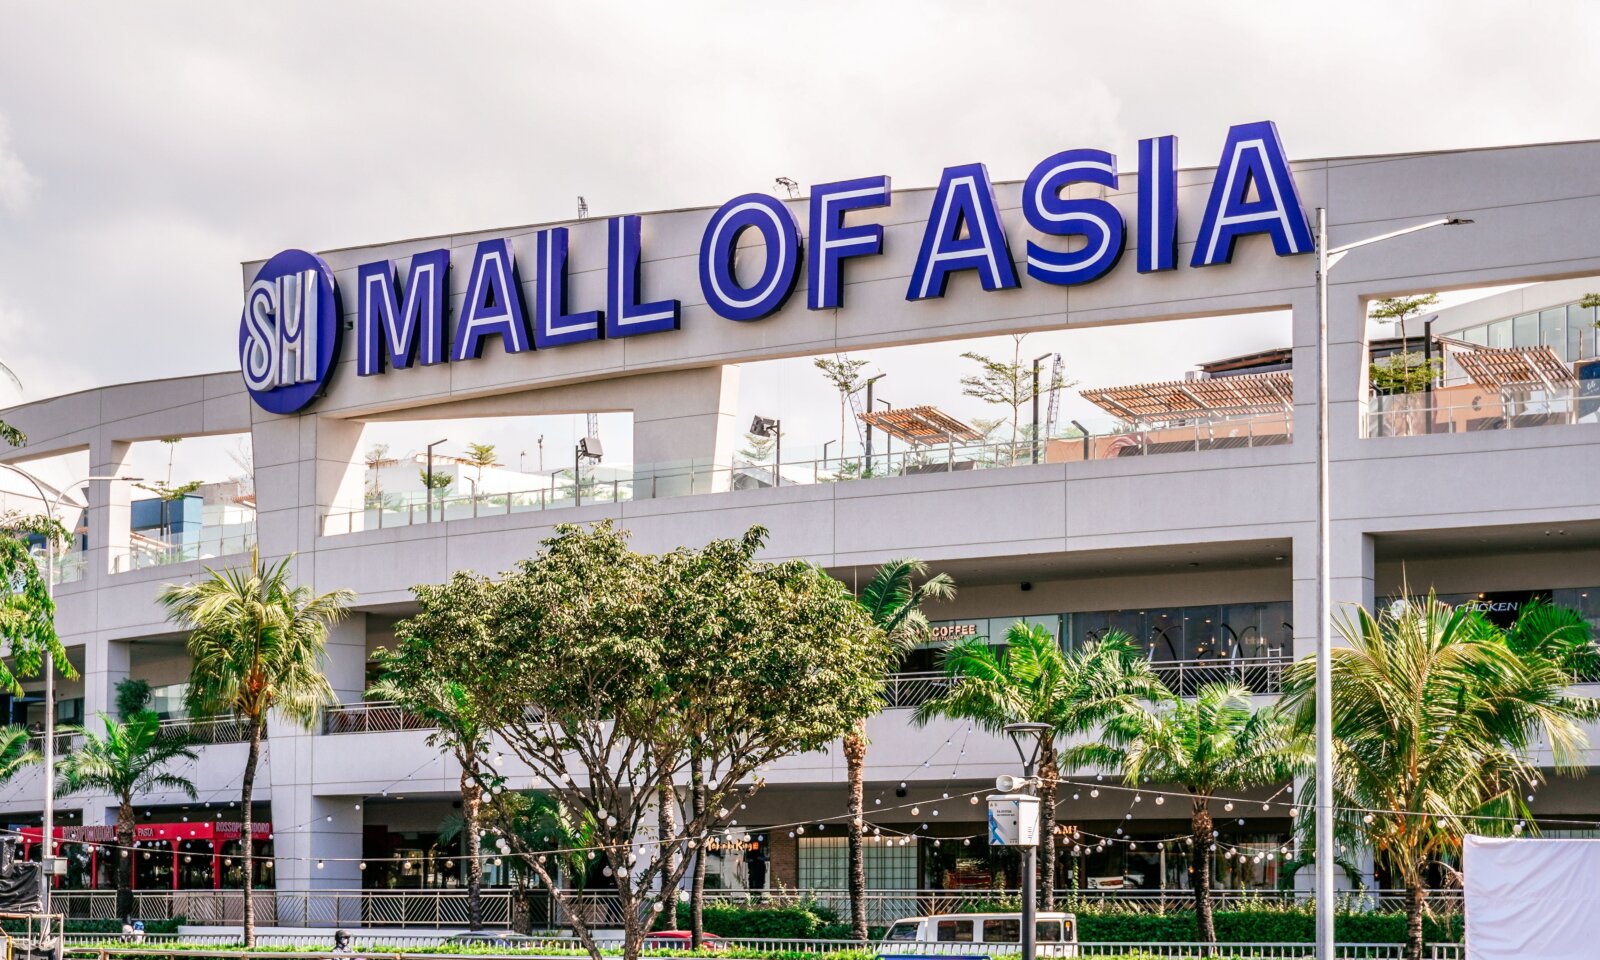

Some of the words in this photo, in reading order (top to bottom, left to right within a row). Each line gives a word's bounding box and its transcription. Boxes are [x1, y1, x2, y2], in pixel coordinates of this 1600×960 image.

[357, 214, 681, 377] MALL
[699, 175, 891, 322] OF
[905, 120, 1314, 301] ASIA
[242, 269, 318, 392] SM
[1455, 602, 1518, 613] CHICKEN
[932, 624, 976, 637] COFFEE
[138, 828, 154, 837] PASTA
[216, 822, 270, 834] ROSSOPDORO
